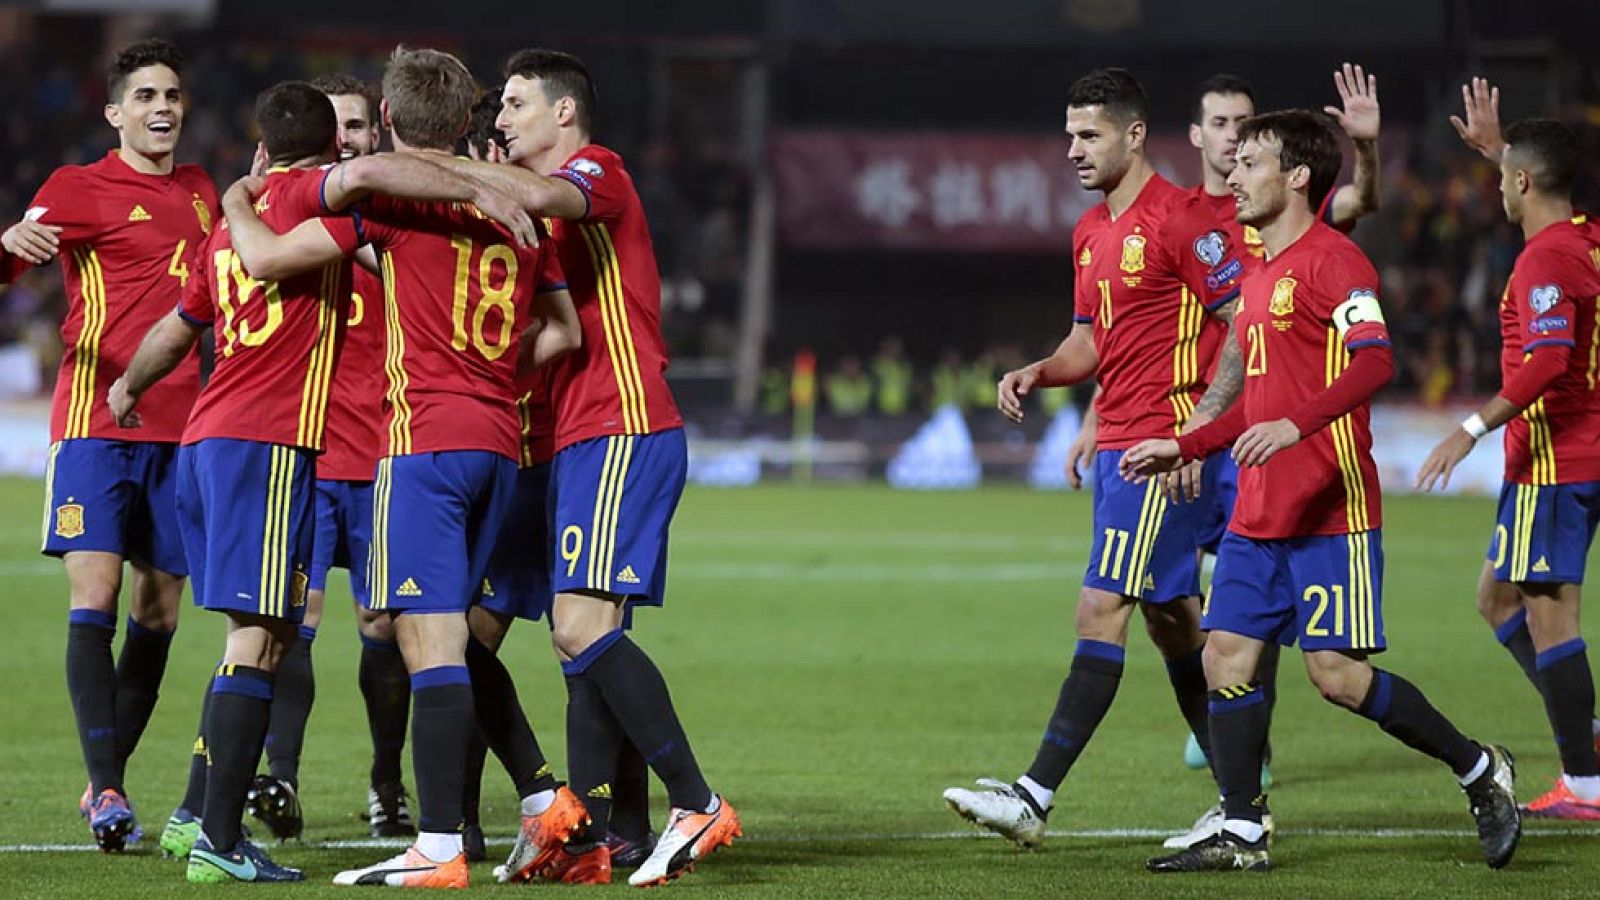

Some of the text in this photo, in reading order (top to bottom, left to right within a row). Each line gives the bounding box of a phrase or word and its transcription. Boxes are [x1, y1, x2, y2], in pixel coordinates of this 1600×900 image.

[168, 239, 190, 287] 4
[451, 234, 518, 361] 18
[1097, 278, 1113, 329] 11
[1344, 305, 1365, 326] C
[1247, 322, 1267, 377] 21
[561, 525, 583, 577] 9
[1099, 528, 1129, 580] 11
[1303, 584, 1344, 637] 21
